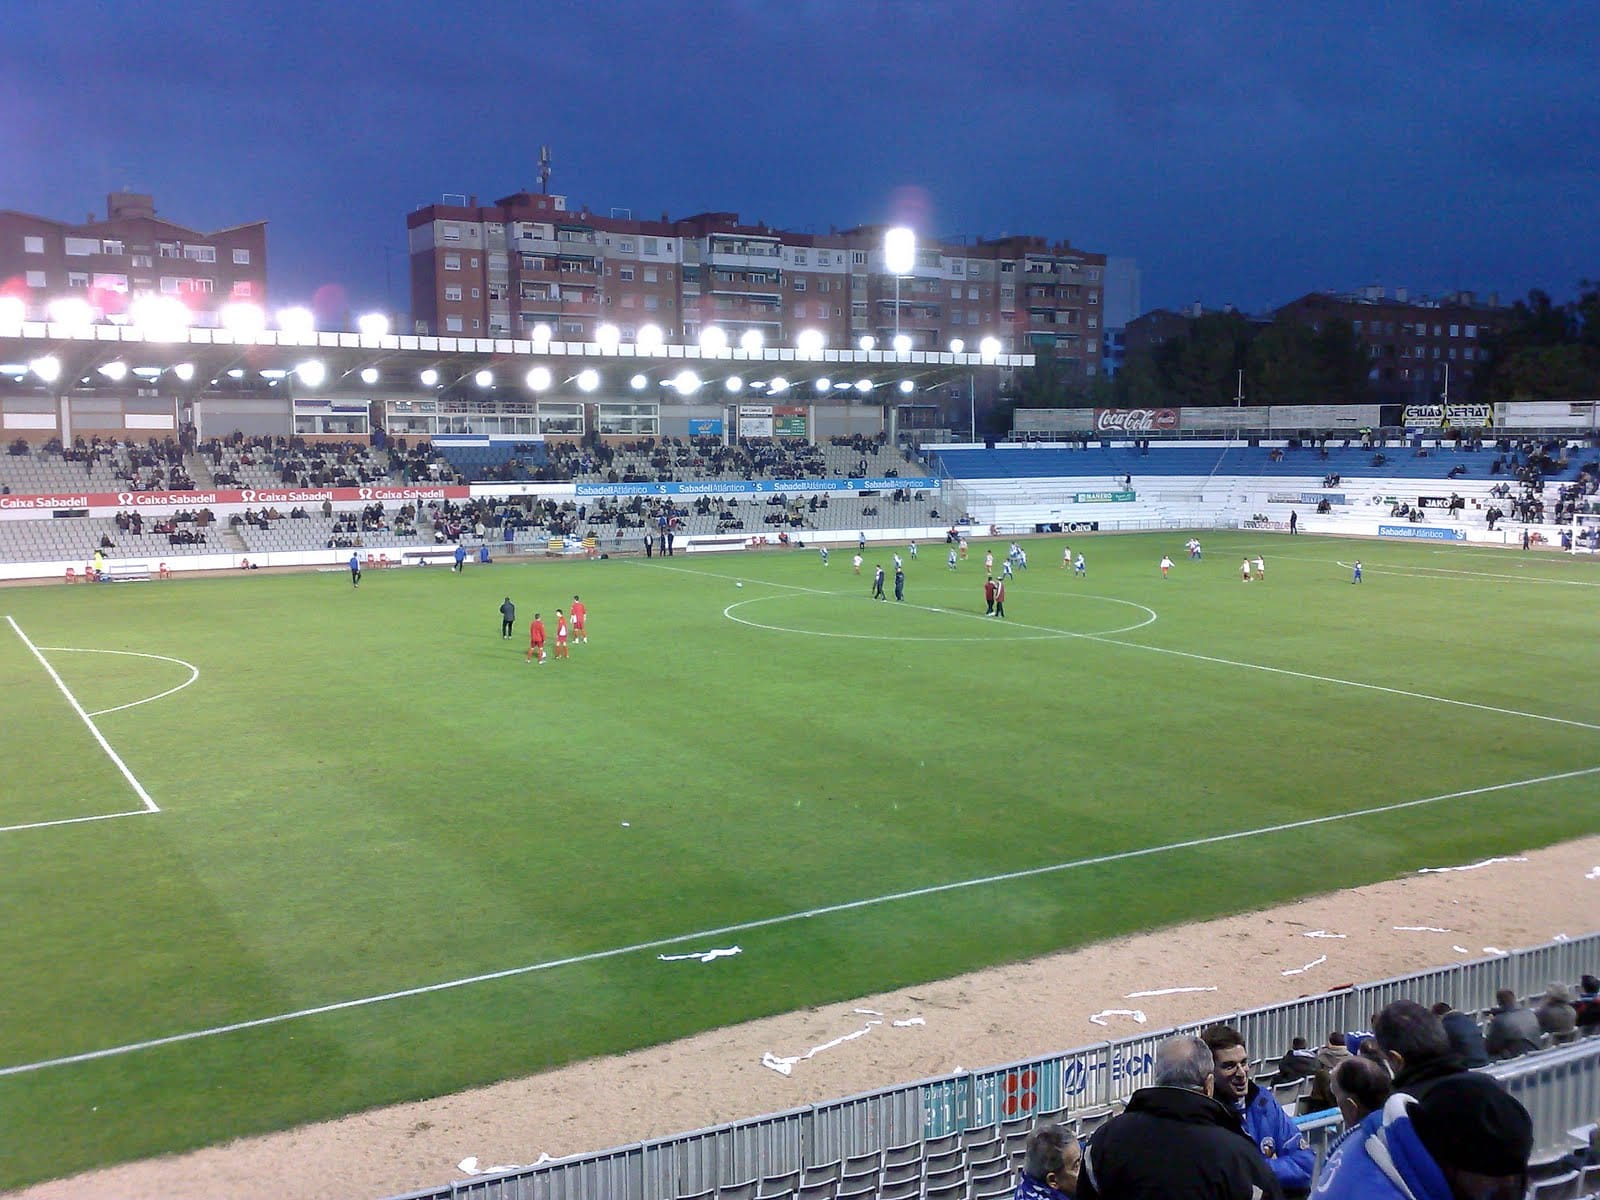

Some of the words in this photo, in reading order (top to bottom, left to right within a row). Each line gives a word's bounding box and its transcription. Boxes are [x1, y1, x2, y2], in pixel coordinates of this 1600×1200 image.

[136, 495, 167, 505] Caixa
[169, 494, 216, 504] Sabadell
[258, 492, 287, 501] Caixa
[288, 491, 332, 501] Sabadell
[375, 491, 401, 499] Caixa
[403, 490, 444, 499] Sabadell
[0, 498, 34, 508] Caixa
[36, 497, 87, 507] Sabadell
[1425, 499, 1450, 508] JAKO
